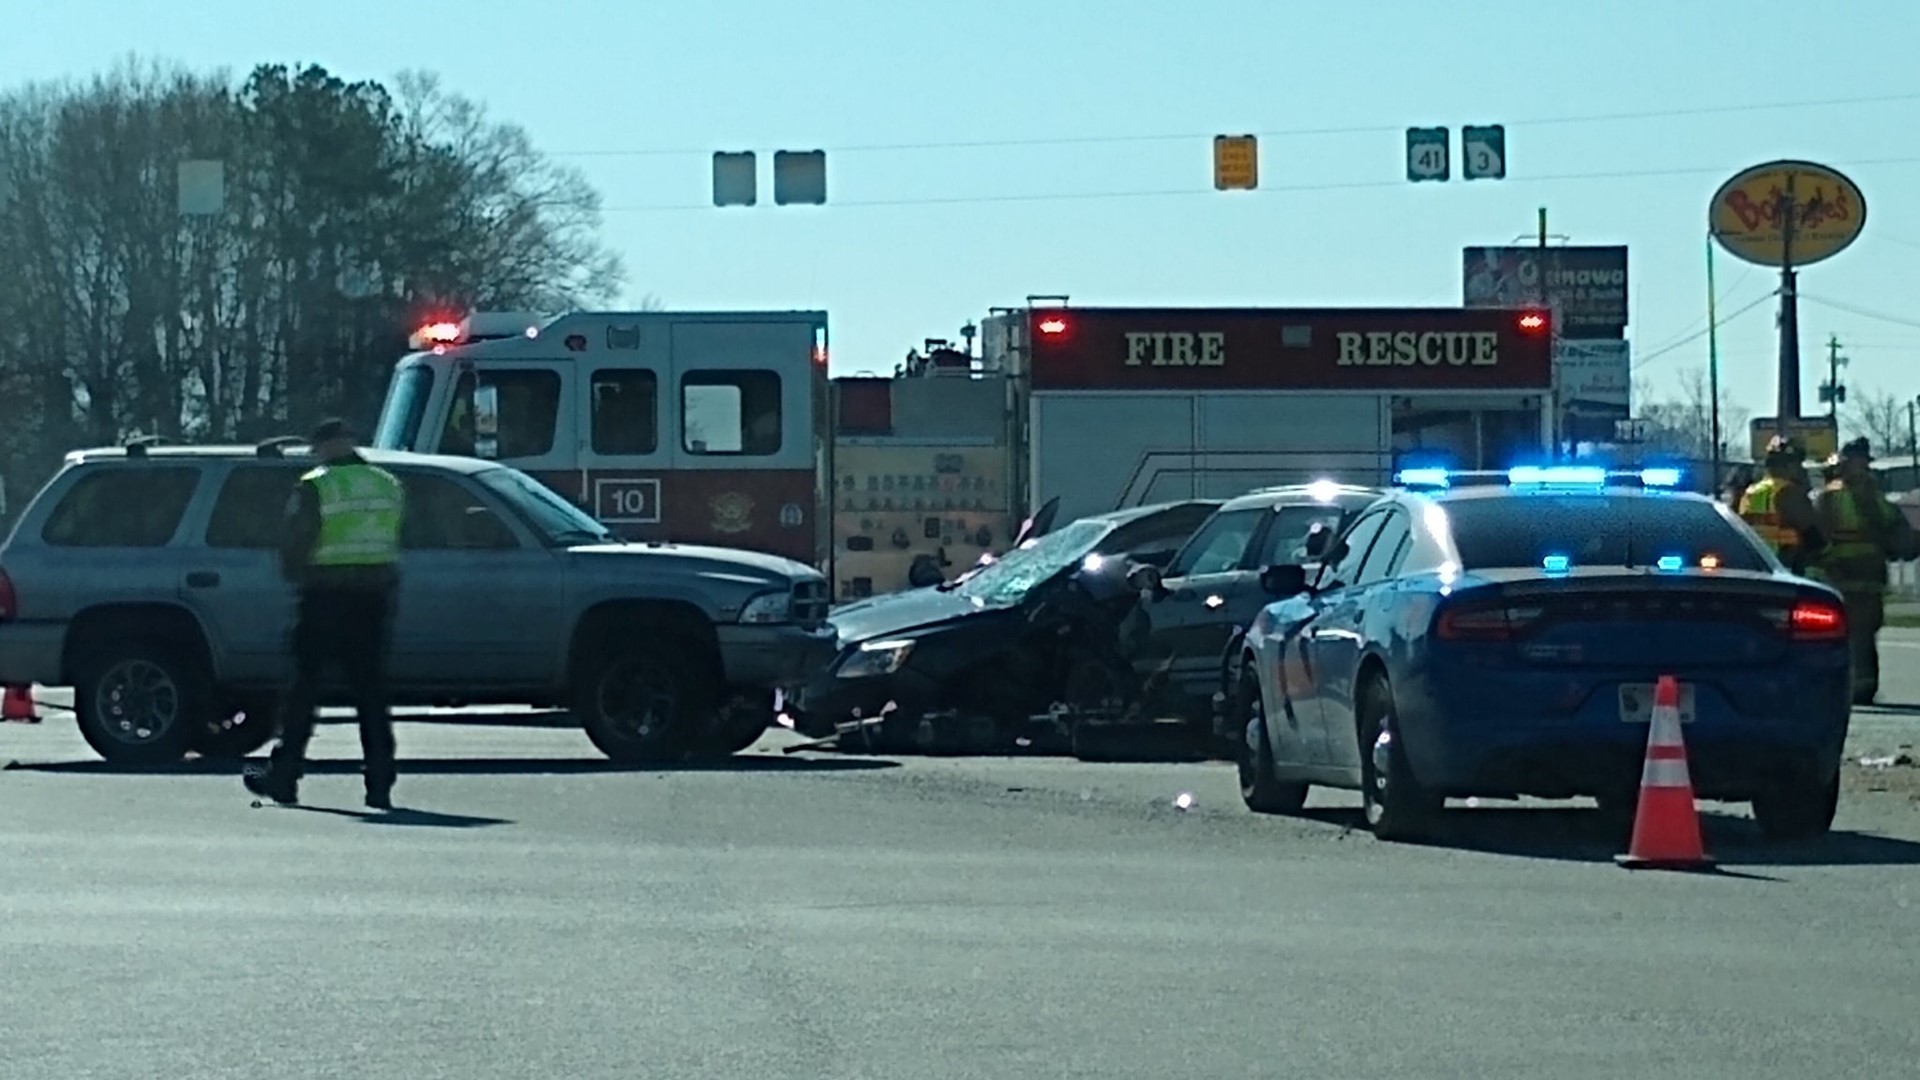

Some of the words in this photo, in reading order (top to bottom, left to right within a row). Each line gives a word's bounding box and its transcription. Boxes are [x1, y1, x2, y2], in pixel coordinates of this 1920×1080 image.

[1418, 150, 1440, 170] 41
[1477, 151, 1491, 171] 3
[1124, 331, 1225, 366] FIRE
[1336, 331, 1498, 366] RESCUE
[611, 489, 644, 514] 10
